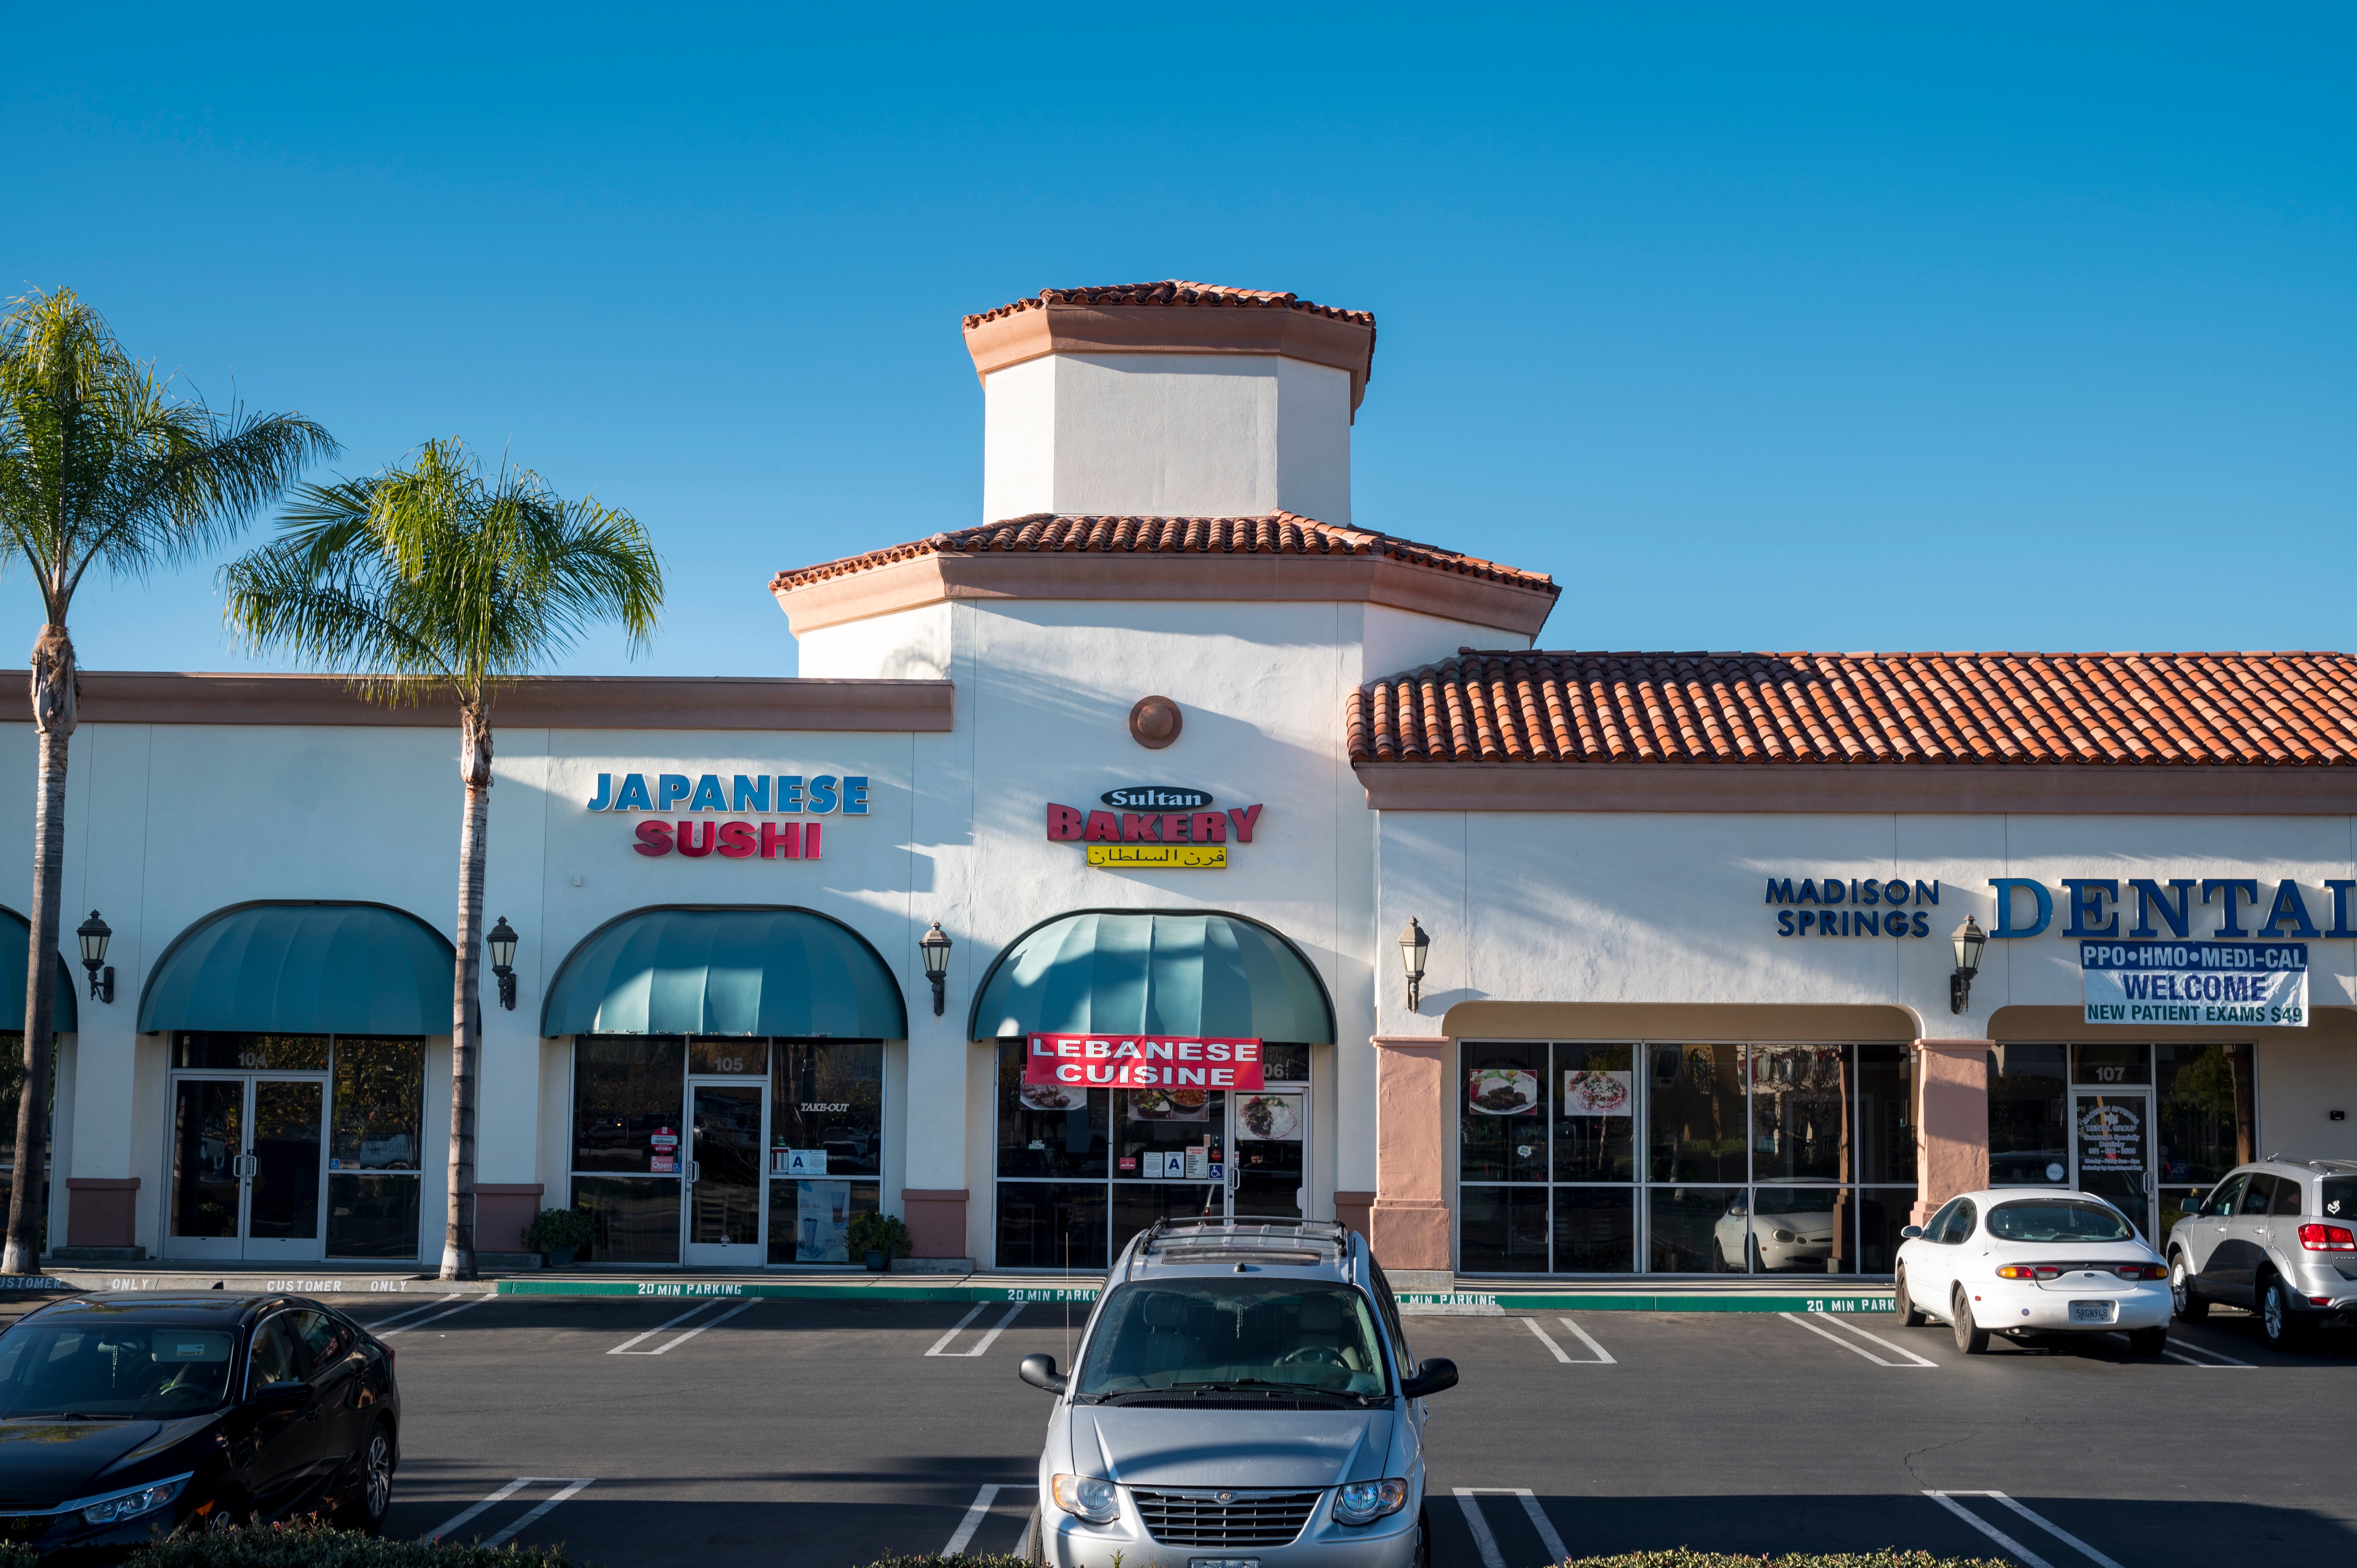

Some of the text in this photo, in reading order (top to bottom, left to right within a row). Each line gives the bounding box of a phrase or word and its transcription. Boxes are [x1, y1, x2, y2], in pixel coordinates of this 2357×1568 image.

[587, 773, 869, 815] JAPANESE
[1111, 790, 1203, 806] Sultan
[1047, 802, 1263, 842] BAKERY
[632, 820, 821, 859] SUSHI
[1088, 848, 1225, 866] فرن السلطان
[1764, 878, 1940, 905] MADISON
[1986, 878, 2357, 939] DENTAL
[1777, 910, 1929, 938] SPRINGS
[2123, 974, 2266, 1001] WELCOME
[2088, 1004, 2303, 1023] NEW PATIENT EXAMS $49
[1032, 1038, 1258, 1062] LEBANESE
[237, 1052, 266, 1066] 104
[715, 1057, 743, 1071] 105
[1055, 1064, 1235, 1086] CUISINE
[1263, 1063, 1284, 1078] 06
[2096, 1066, 2125, 1081] 107
[801, 1103, 850, 1112] TAKE-OUT
[2082, 1105, 2140, 1125] MADISON SPRINGS
[652, 1162, 672, 1170] Open
[792, 1156, 804, 1168] A
[1169, 1158, 1180, 1169] A
[0, 1278, 149, 1290] USTOMER ONLY
[267, 1280, 406, 1292] CUSTOMER ONLY
[638, 1283, 742, 1296] 20 MIN PARKING
[1007, 1289, 1099, 1301] 20 MIN PARKI
[1409, 1295, 1432, 1304] MIN
[1440, 1294, 1496, 1305] PARKING
[1806, 1299, 1896, 1312] 20 MIN PARK
[2076, 1308, 2108, 1318] 5RGN948
